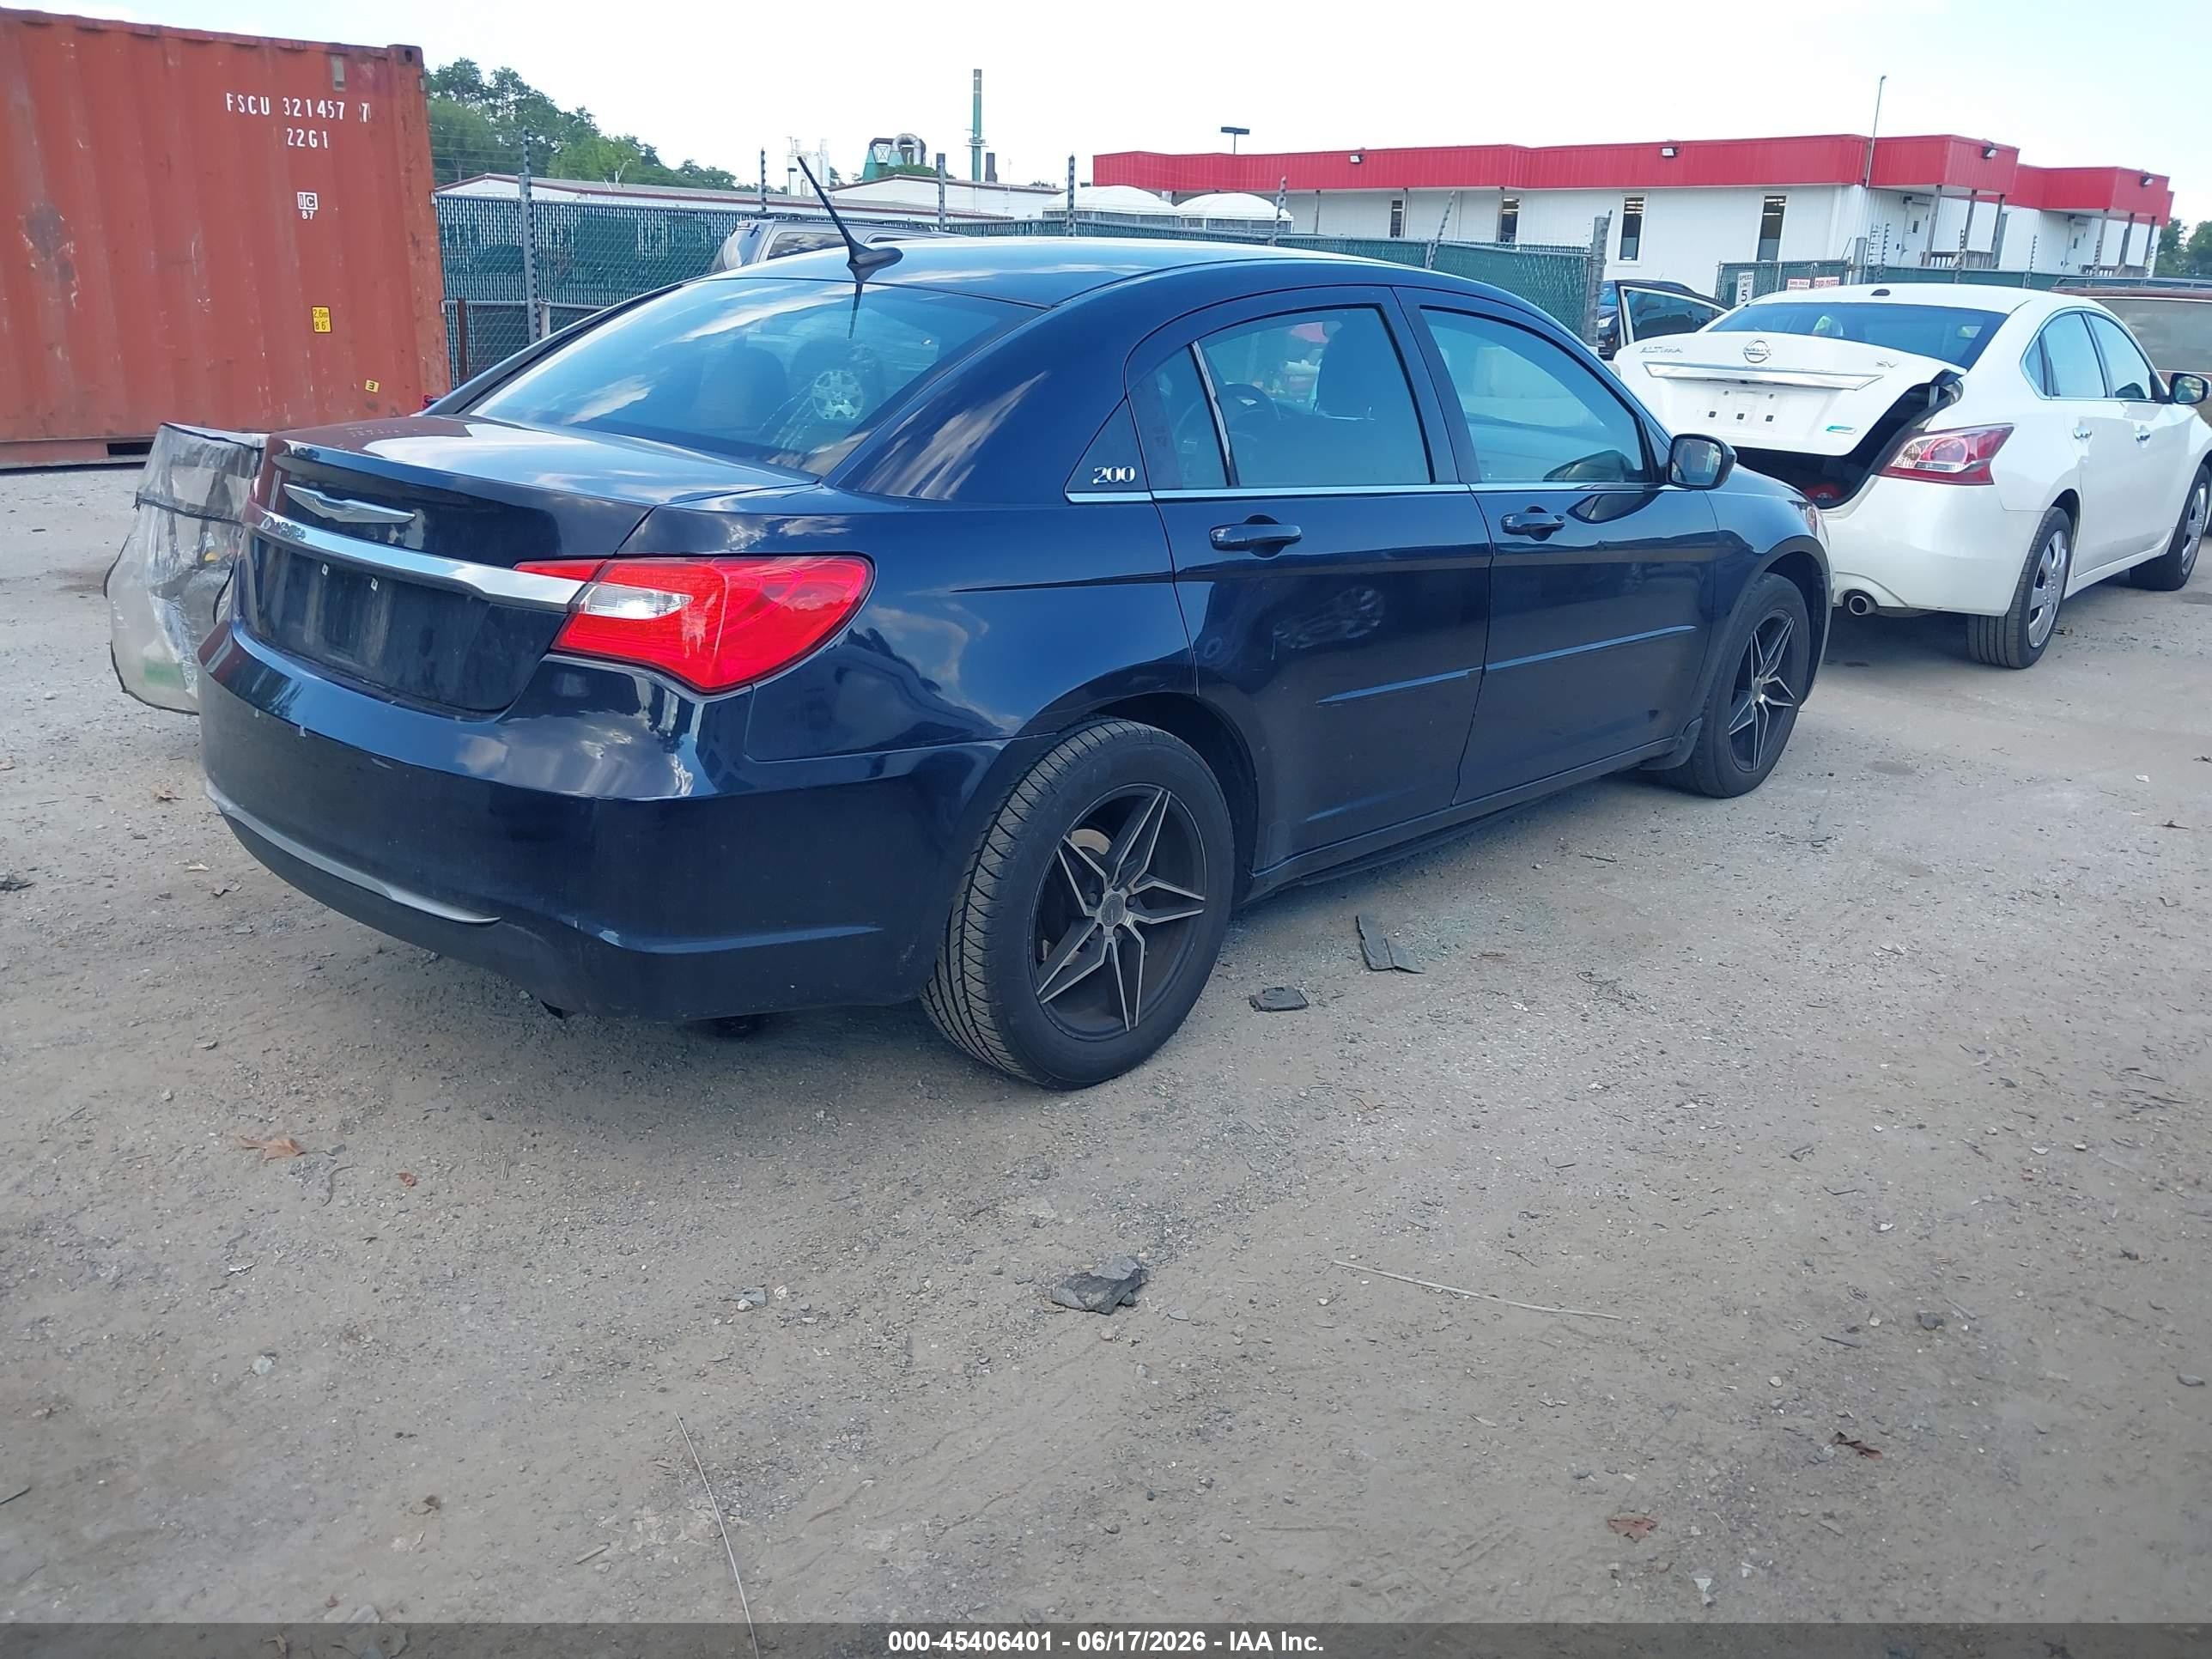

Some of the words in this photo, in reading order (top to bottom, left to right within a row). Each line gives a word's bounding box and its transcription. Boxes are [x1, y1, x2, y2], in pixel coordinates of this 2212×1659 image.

[226, 92, 270, 115] FSCU
[283, 97, 345, 120] 321457
[287, 127, 329, 149] 22G1
[301, 210, 314, 220] 87
[1741, 289, 1747, 301] 5
[1092, 465, 1136, 484] 200
